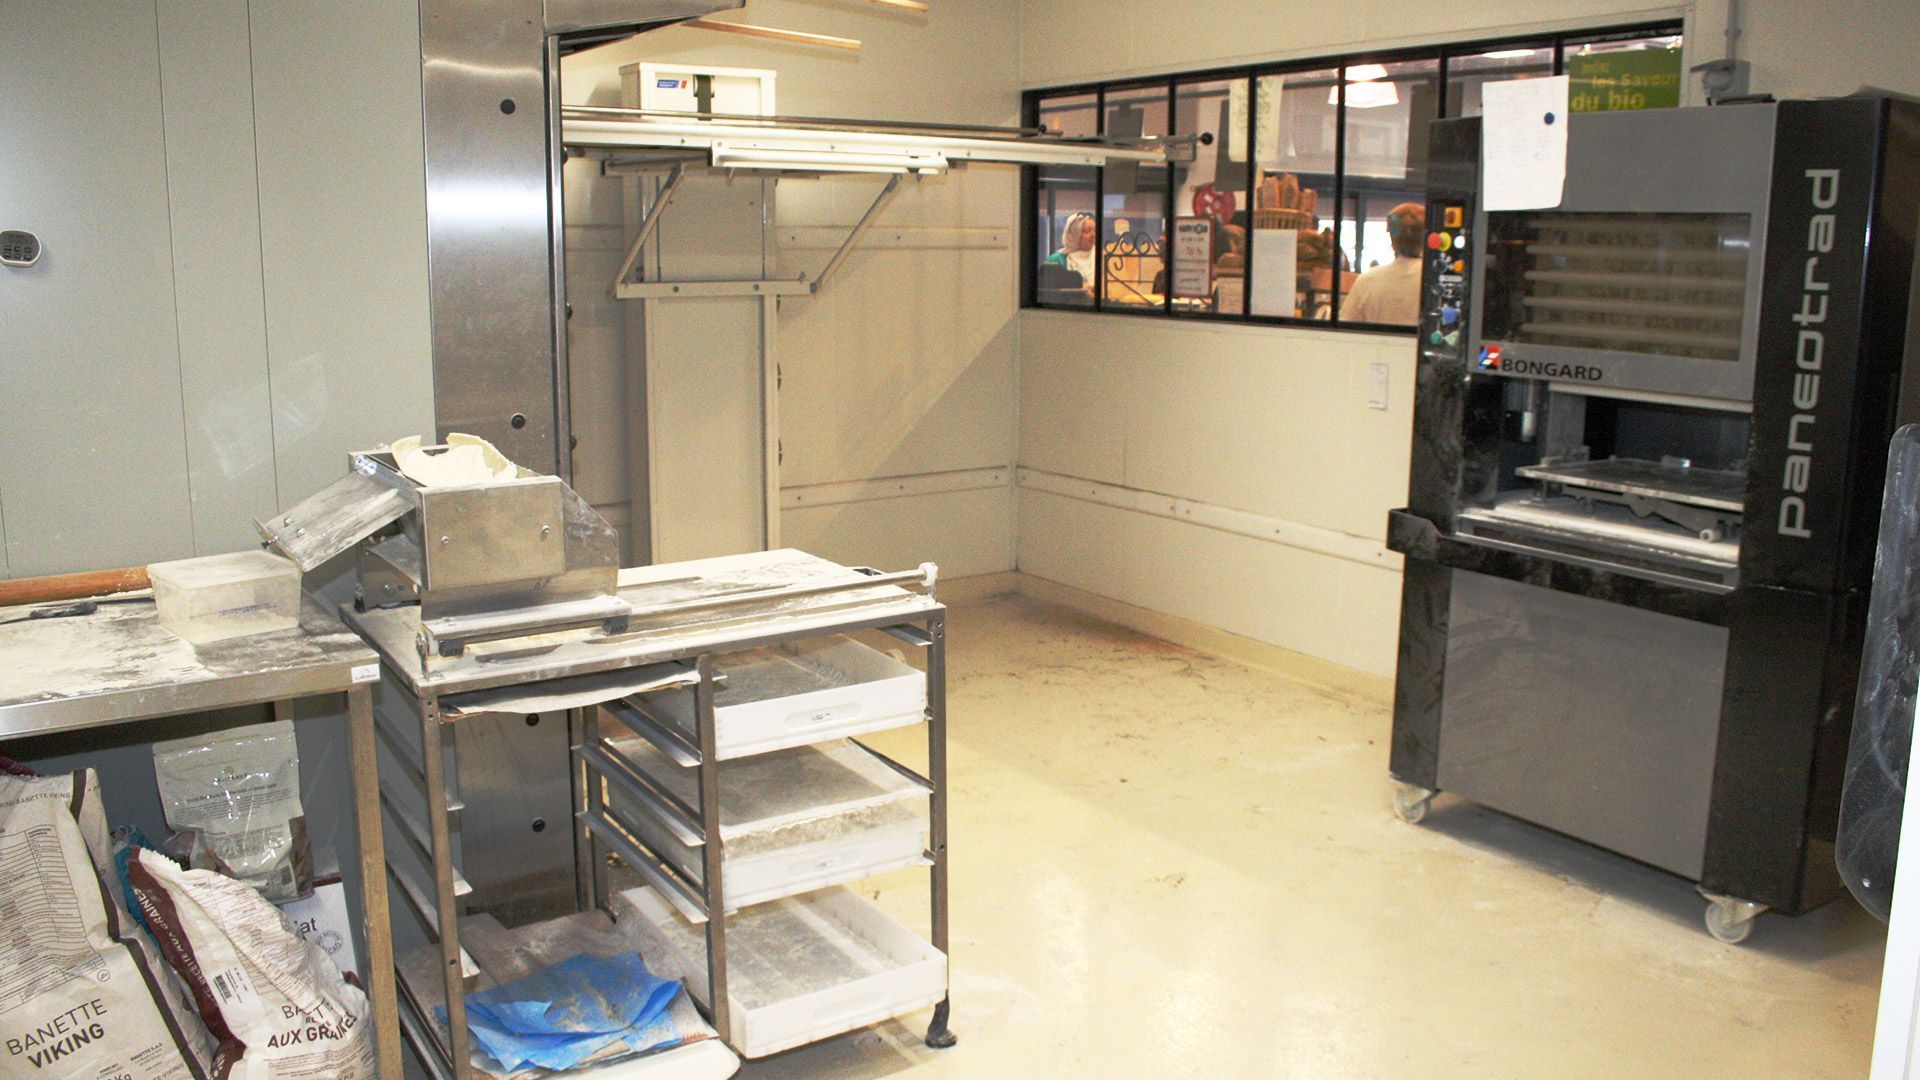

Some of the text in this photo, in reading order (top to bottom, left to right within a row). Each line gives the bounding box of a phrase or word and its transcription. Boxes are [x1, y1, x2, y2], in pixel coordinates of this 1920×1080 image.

[1572, 89, 1645, 111] du bio
[1502, 358, 1603, 381] BONGARD
[1778, 168, 1841, 539] paneotrad
[6, 998, 107, 1055] BANETTE
[267, 1028, 303, 1049] AUX
[27, 1022, 105, 1069] VIKING
